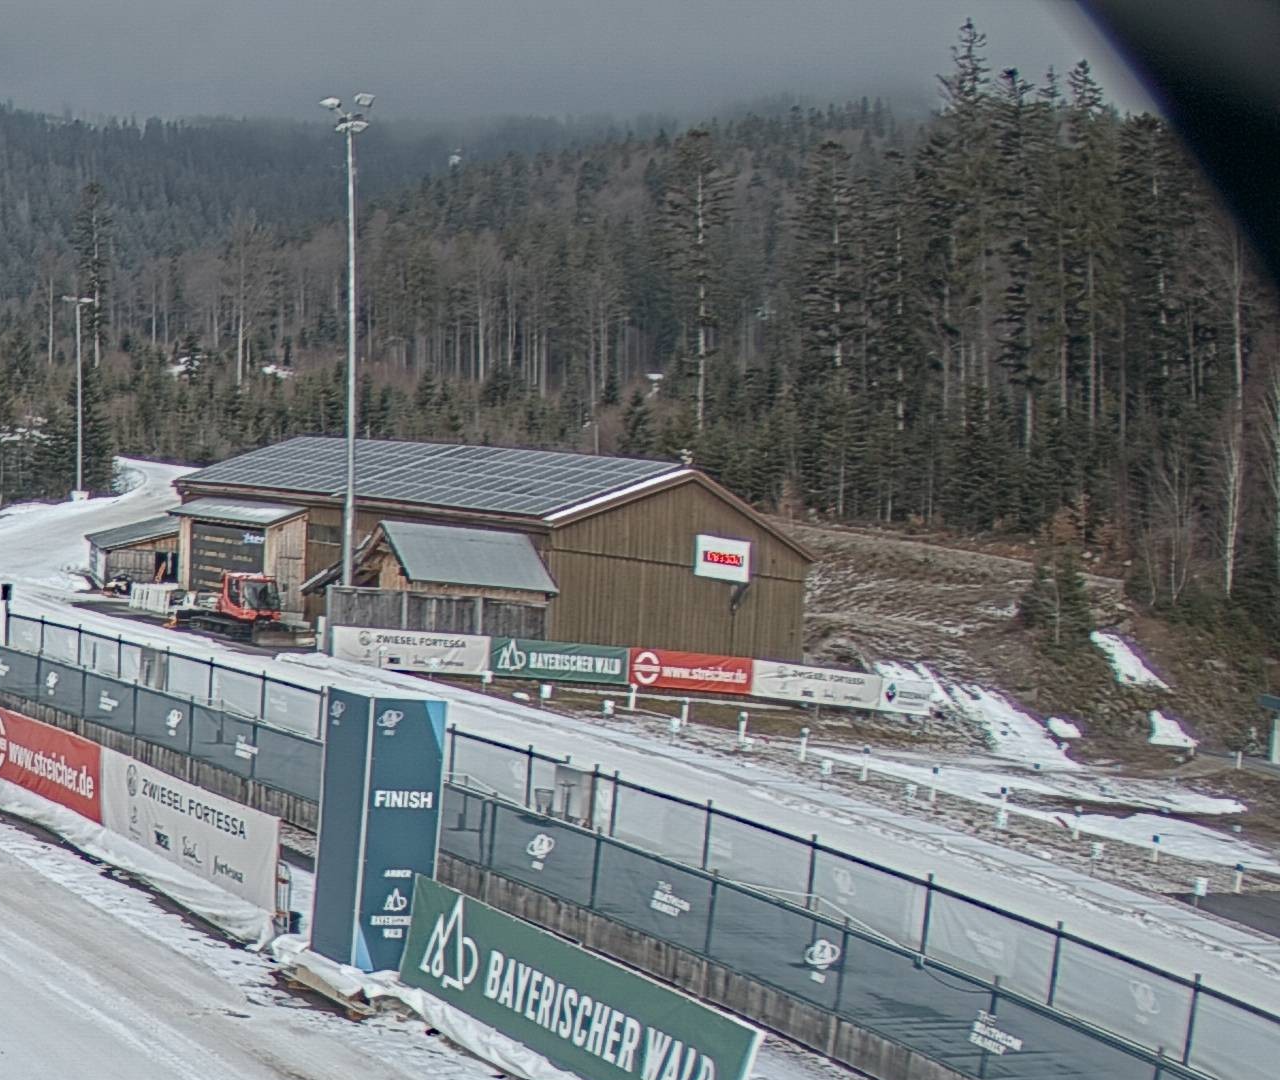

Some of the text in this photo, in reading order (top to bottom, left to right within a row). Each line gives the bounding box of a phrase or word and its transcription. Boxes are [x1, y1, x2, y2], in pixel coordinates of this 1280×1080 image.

[529, 652, 594, 673] BAYERISCHER
[595, 658, 621, 675] WALD
[662, 666, 748, 684] www.streicher.de
[9, 740, 94, 799] www.streicher.de
[142, 778, 247, 840] ZWIESEL FORTESSA
[374, 790, 433, 809] FINISH
[483, 950, 642, 1073] BAYERISCHER
